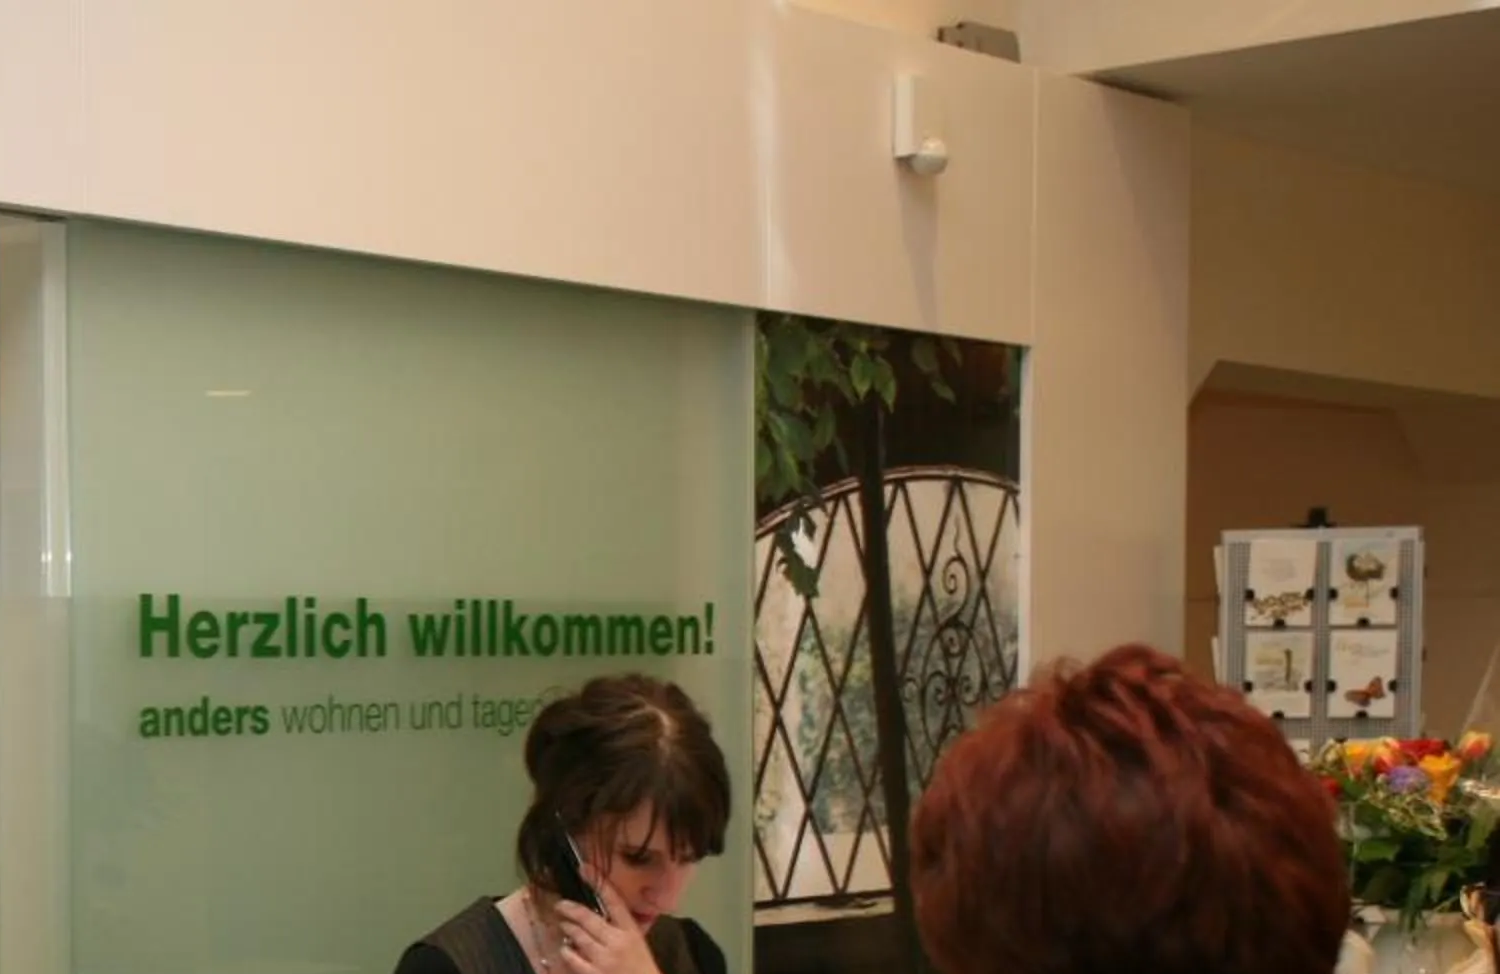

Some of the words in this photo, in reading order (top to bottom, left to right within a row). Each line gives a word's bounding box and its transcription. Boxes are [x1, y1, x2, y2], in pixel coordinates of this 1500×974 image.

[139, 594, 387, 658] Herzlich
[408, 599, 714, 656] willkommen!
[139, 696, 269, 738] anders
[282, 694, 398, 734] wohnen
[409, 692, 462, 730] und
[471, 692, 543, 737] tage
